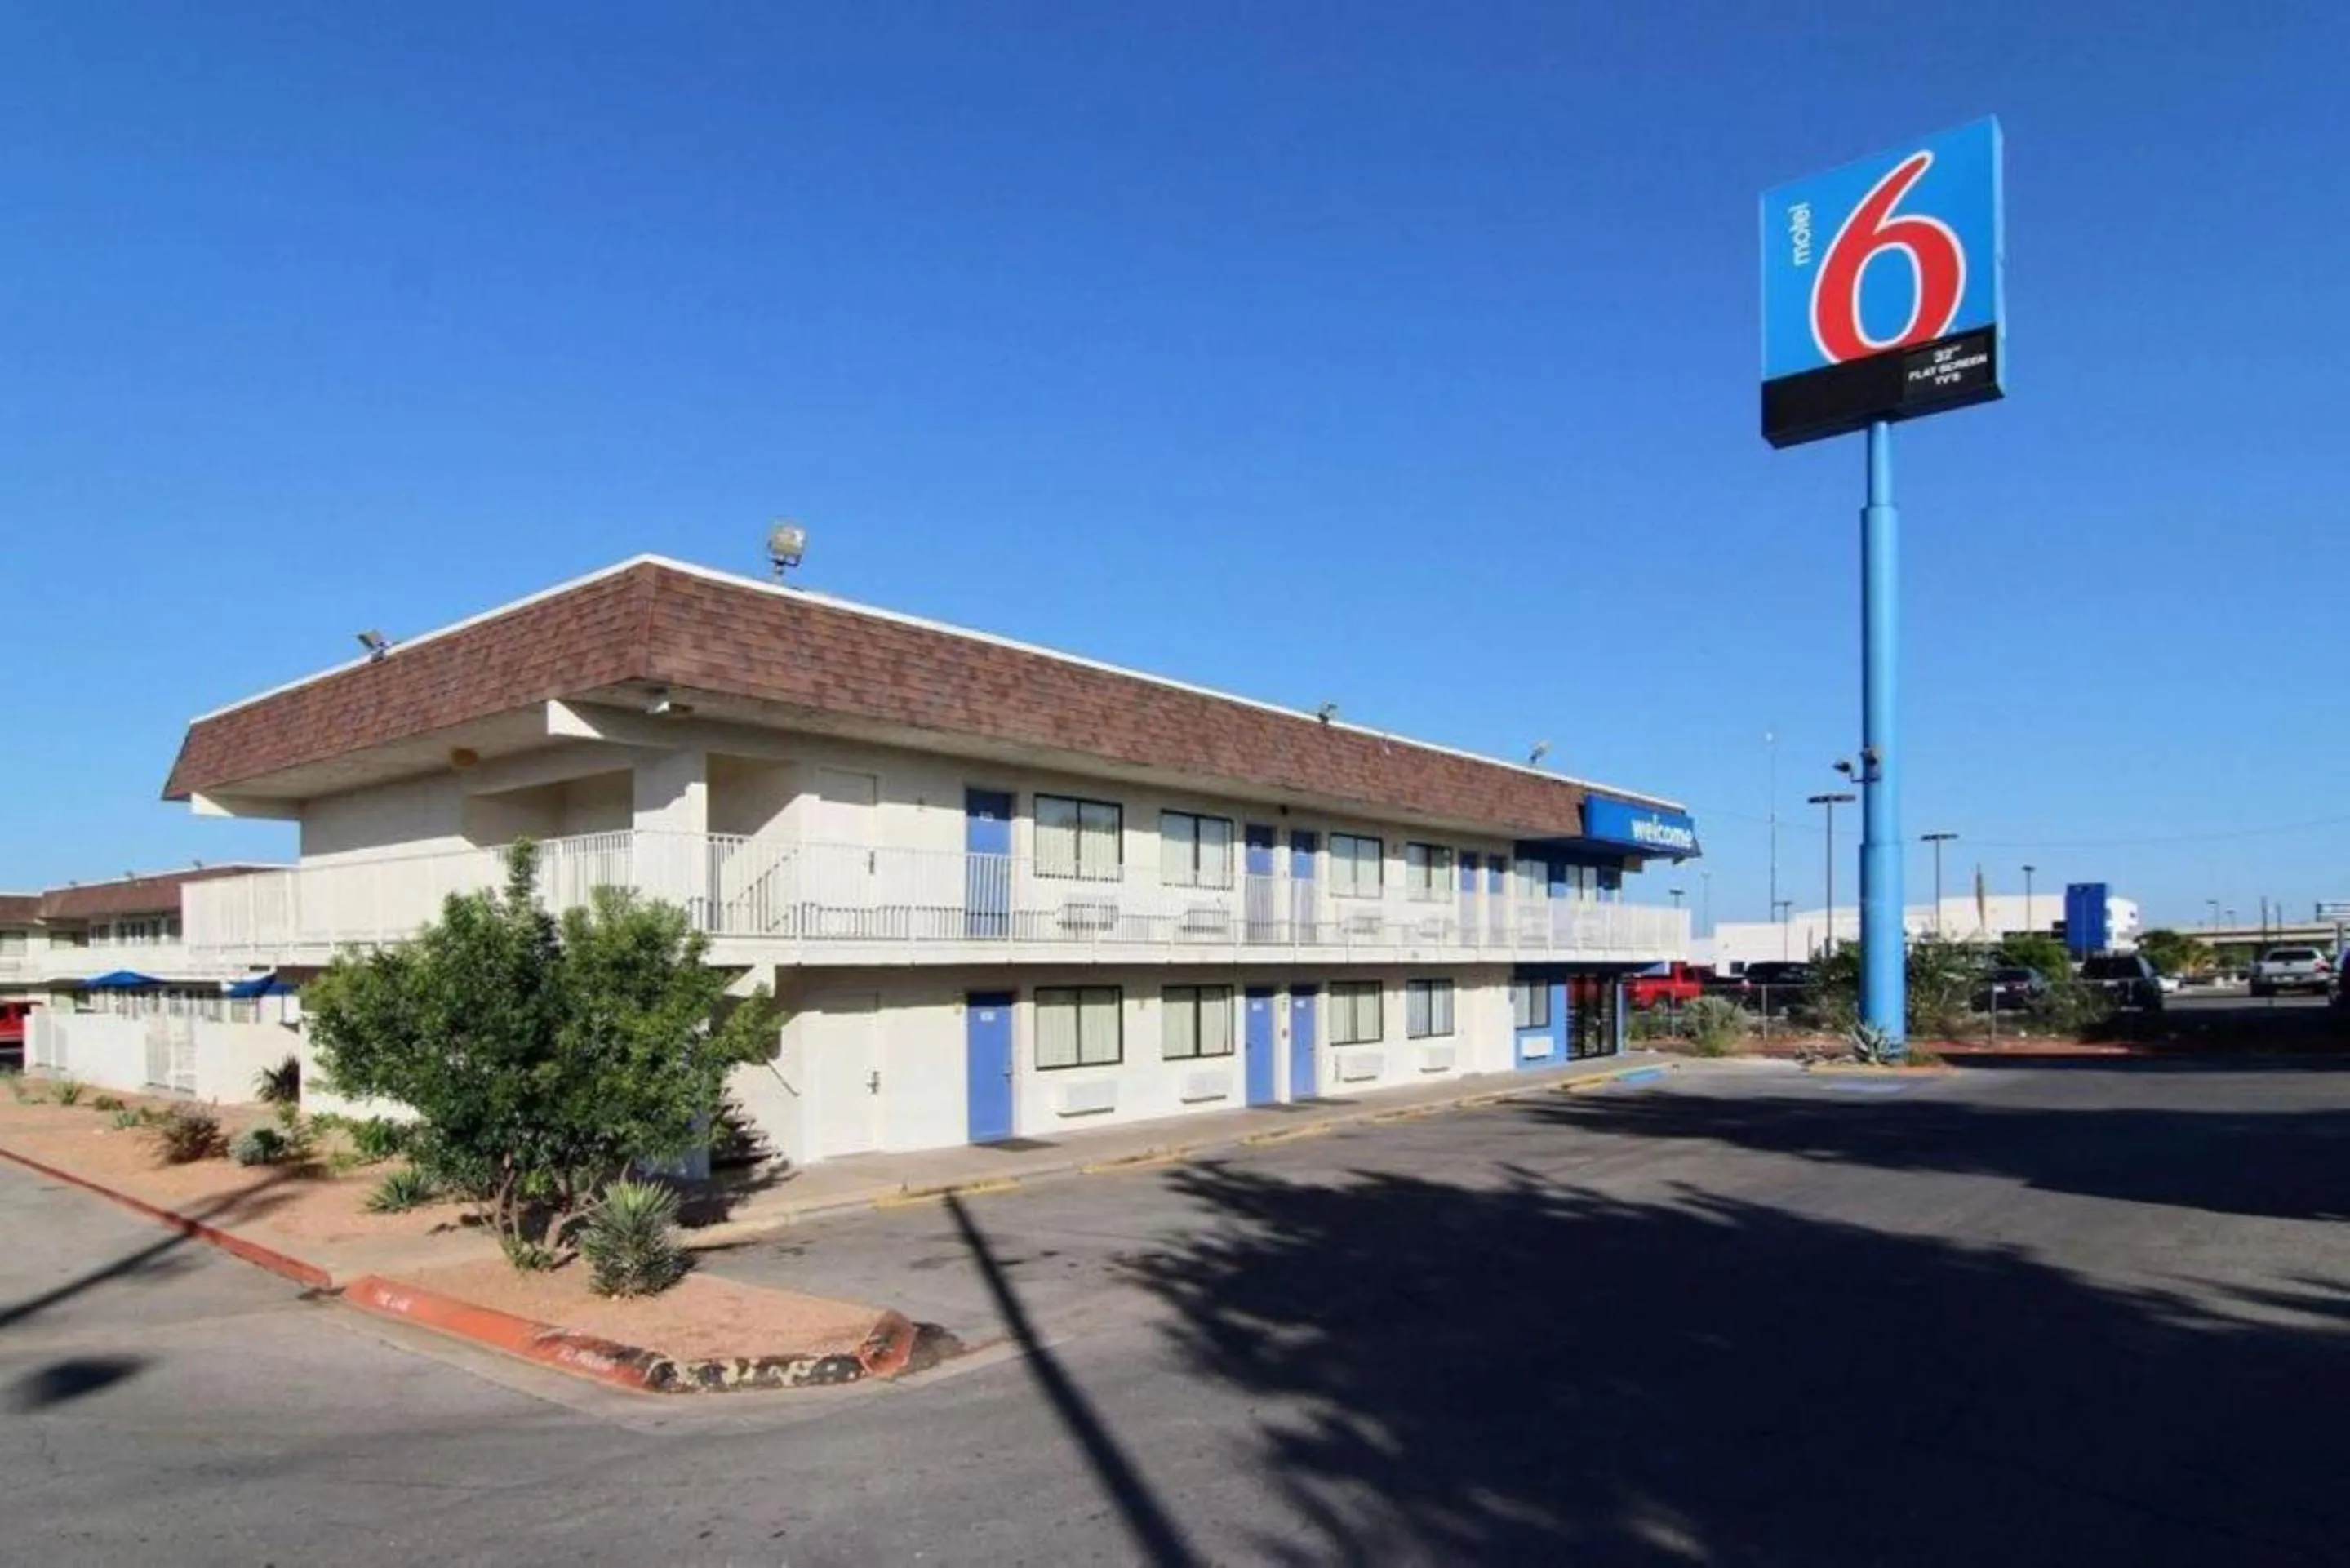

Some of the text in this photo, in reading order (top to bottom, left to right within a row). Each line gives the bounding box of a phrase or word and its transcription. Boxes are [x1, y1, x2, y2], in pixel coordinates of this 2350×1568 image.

[1788, 202, 1811, 266] motel
[1810, 149, 1966, 364] 6
[1631, 814, 1693, 849] welcome
